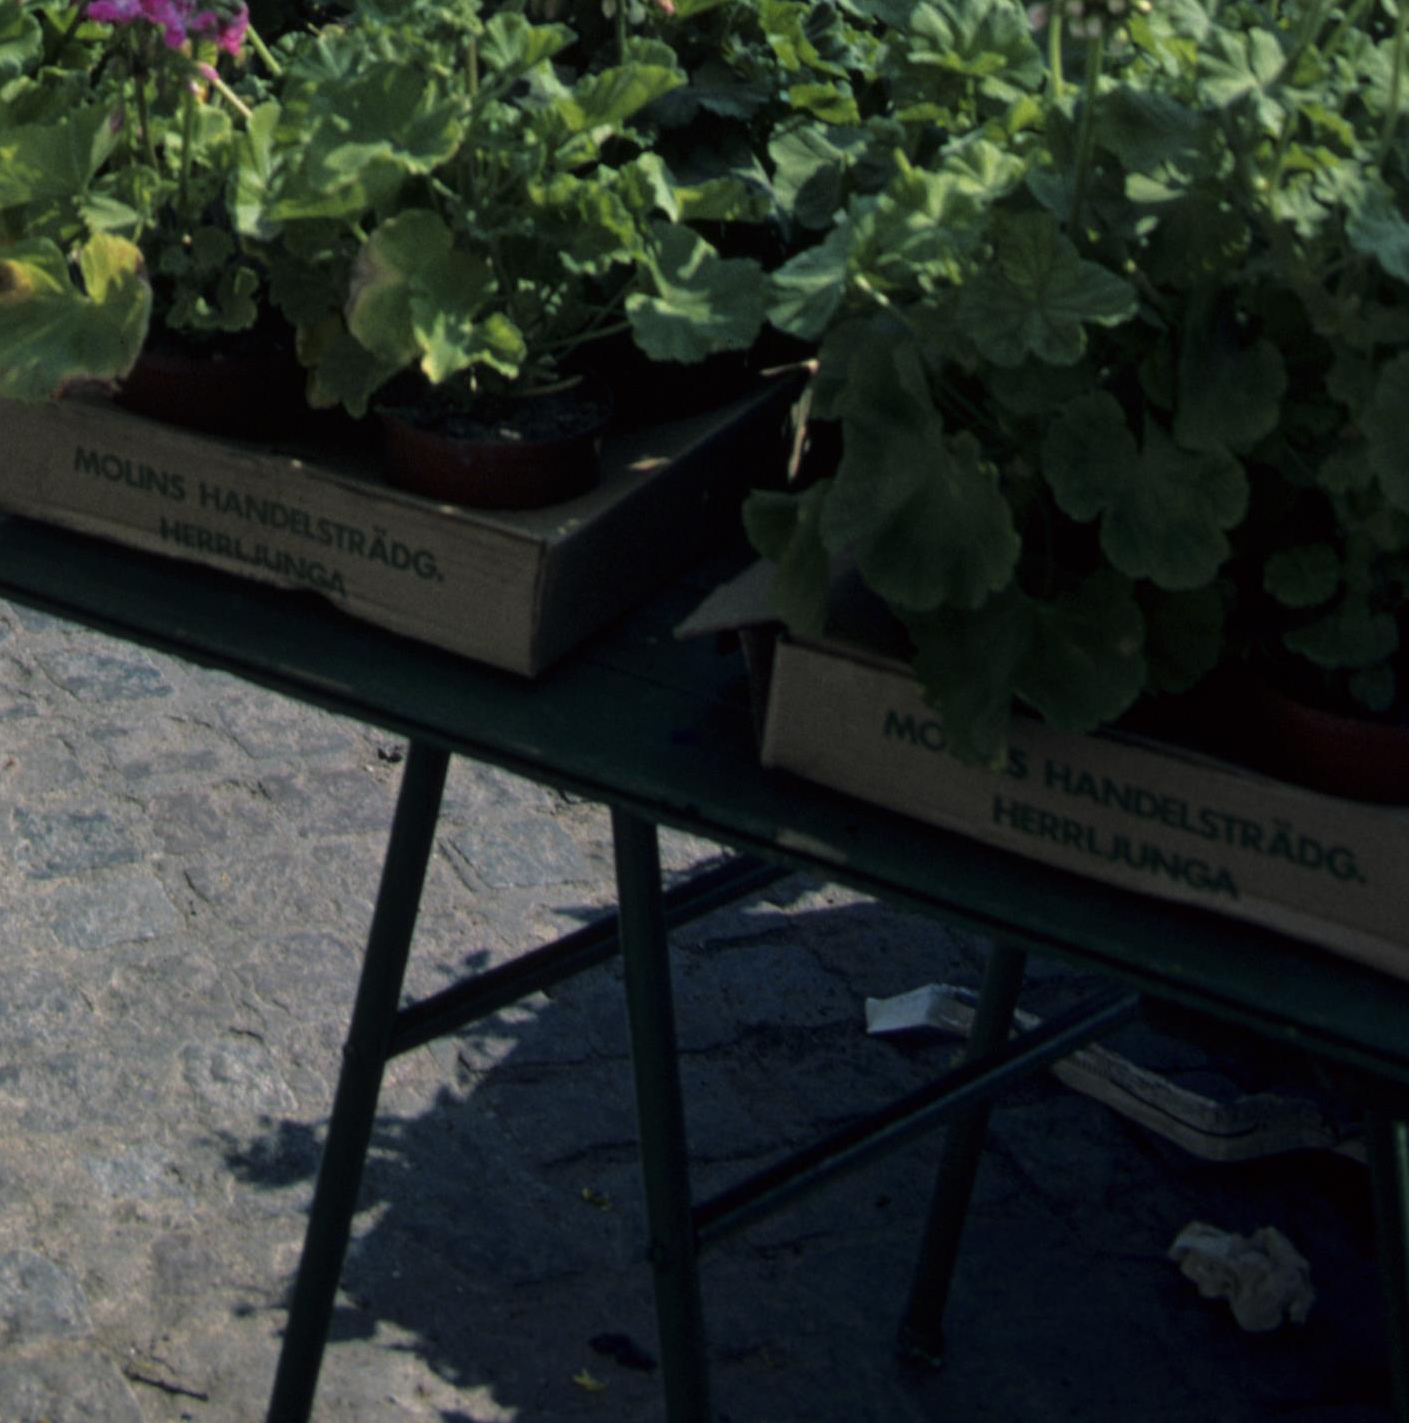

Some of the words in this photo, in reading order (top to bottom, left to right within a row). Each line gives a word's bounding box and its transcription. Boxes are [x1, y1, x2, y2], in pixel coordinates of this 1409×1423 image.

[74, 445, 187, 502] MOLINS
[199, 481, 445, 583] HANDELSTRÄDG.
[159, 516, 347, 599] HERRLJUNGA
[884, 709, 1031, 779] MOS
[1043, 758, 1368, 884] HANDELSTRÄDG.
[993, 796, 1239, 900] HERRLJUNGA
